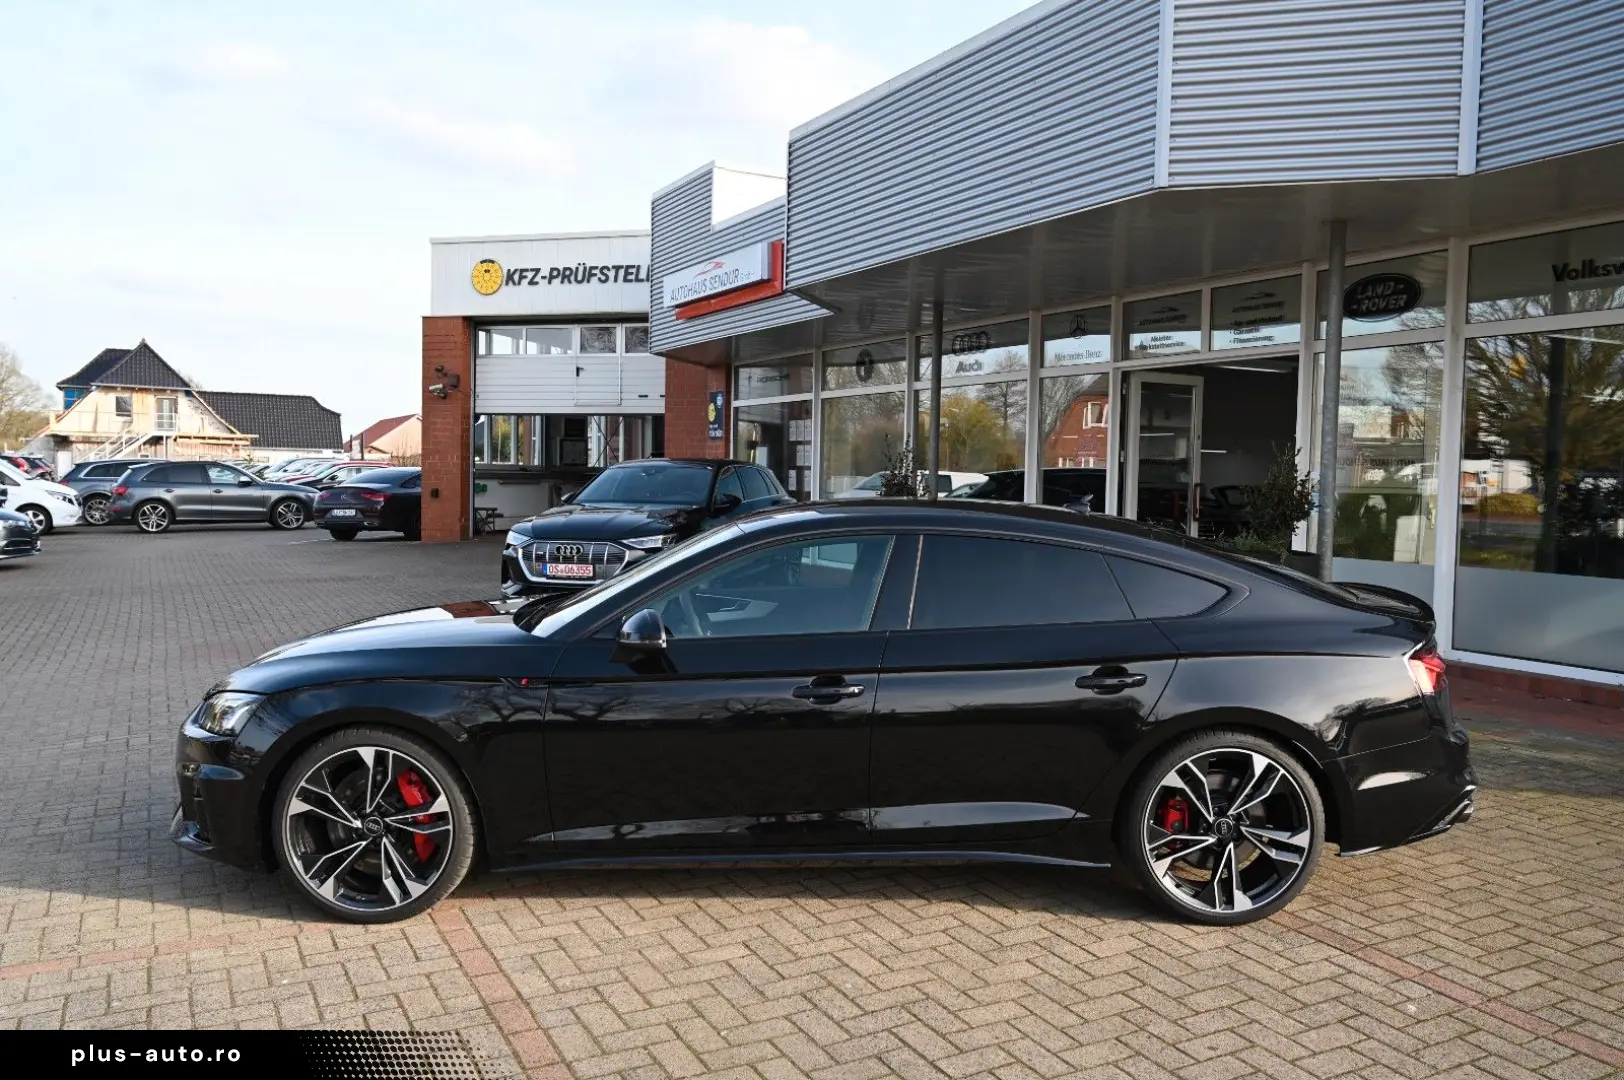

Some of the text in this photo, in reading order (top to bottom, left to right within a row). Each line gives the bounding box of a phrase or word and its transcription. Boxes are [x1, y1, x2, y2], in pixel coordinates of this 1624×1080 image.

[669, 279, 707, 301] AUTOHAUS
[708, 268, 740, 290] SENDUR
[955, 359, 983, 373] Audi
[549, 564, 592, 575] OS 06355
